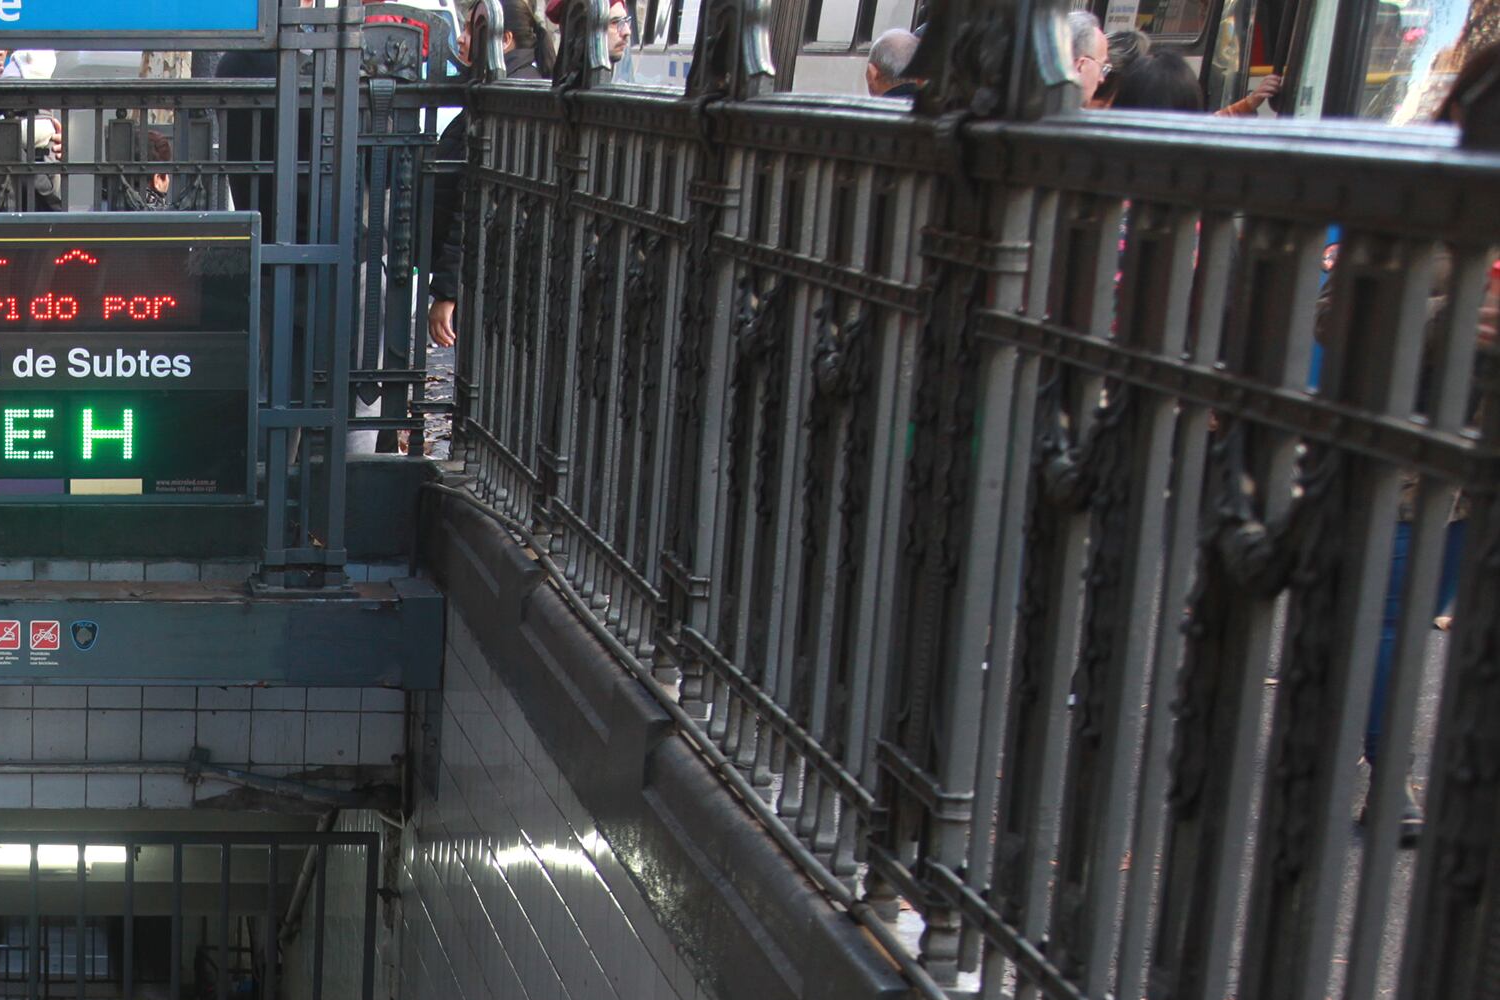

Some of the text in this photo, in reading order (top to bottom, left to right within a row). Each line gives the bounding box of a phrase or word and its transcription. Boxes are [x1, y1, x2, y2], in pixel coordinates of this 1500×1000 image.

[12, 349, 57, 378] de
[67, 348, 192, 378] Subtes
[4, 408, 54, 459] E
[82, 408, 133, 460] H
